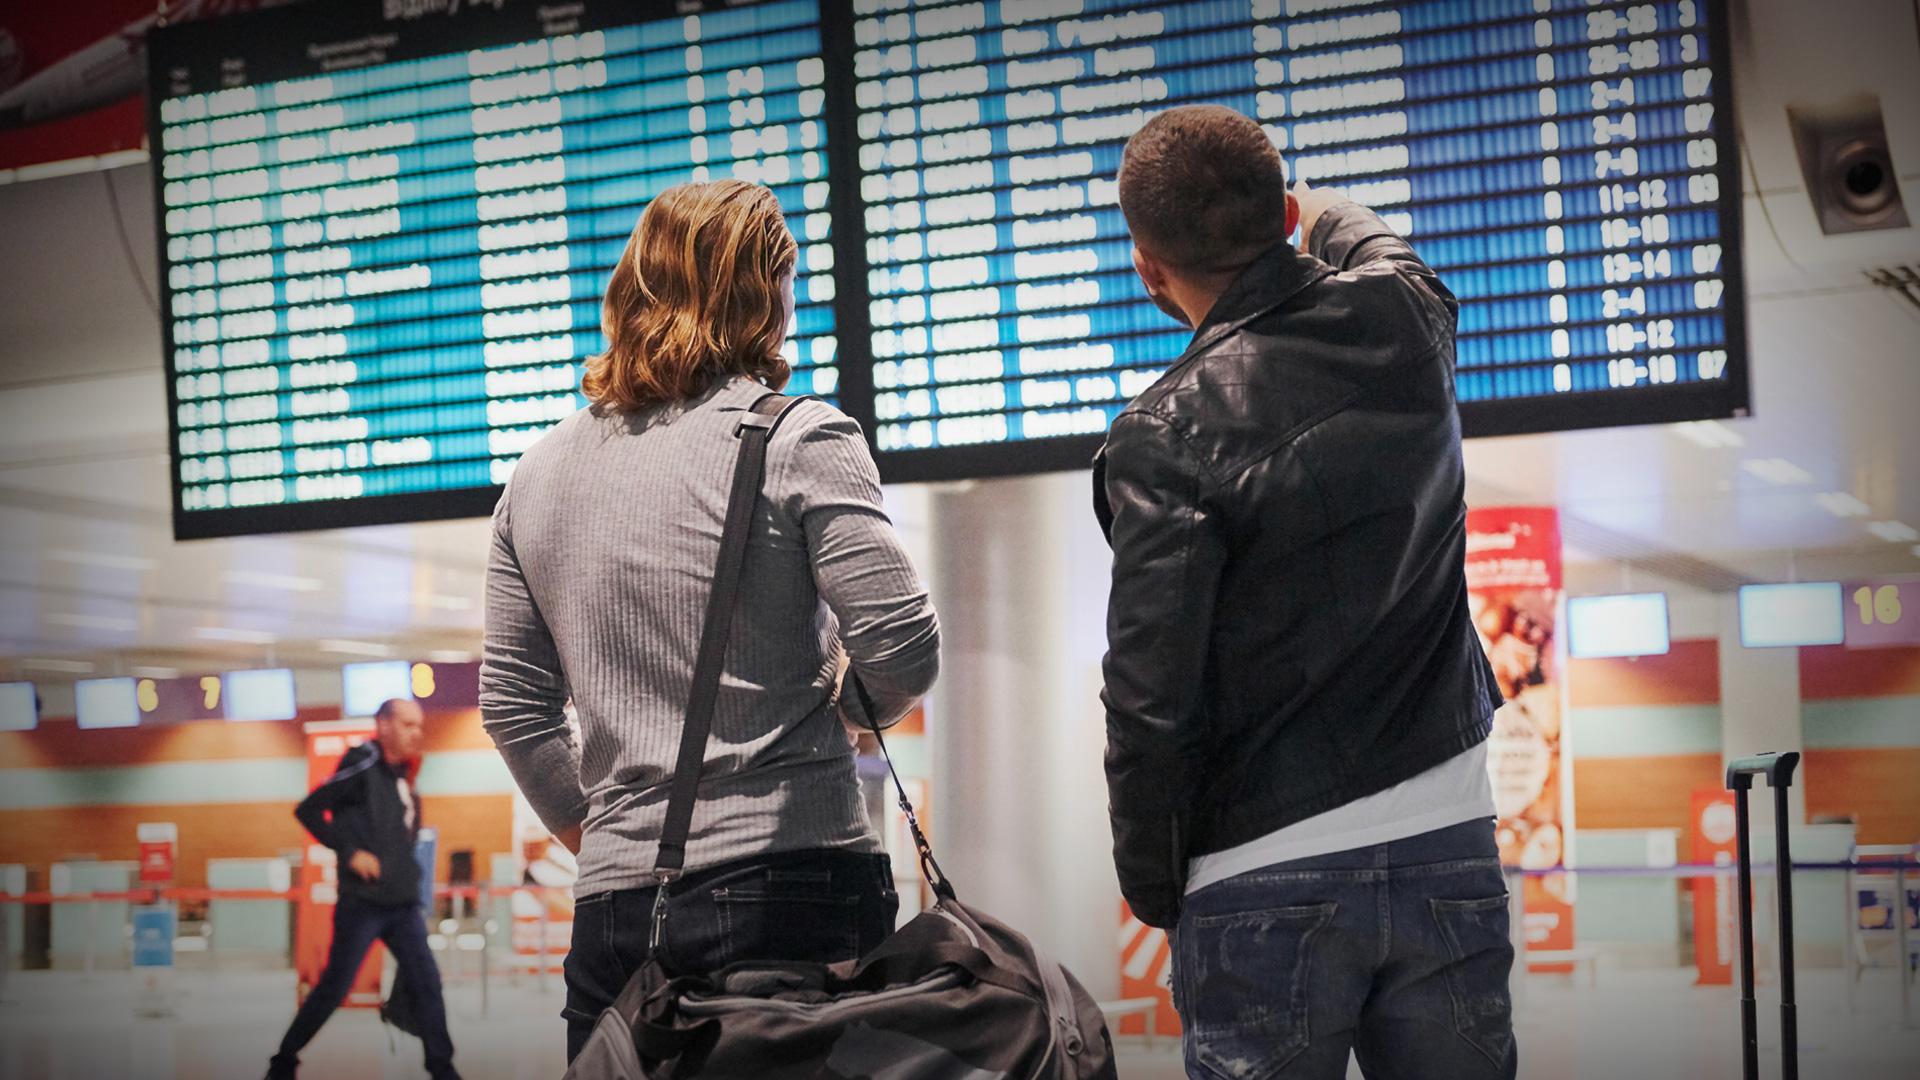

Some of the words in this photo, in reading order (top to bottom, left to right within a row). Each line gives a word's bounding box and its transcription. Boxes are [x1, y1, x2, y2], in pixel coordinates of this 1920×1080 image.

[1853, 585, 1901, 624] 16
[137, 679, 158, 712] 6
[200, 676, 221, 709] 7
[411, 662, 436, 698] 8
